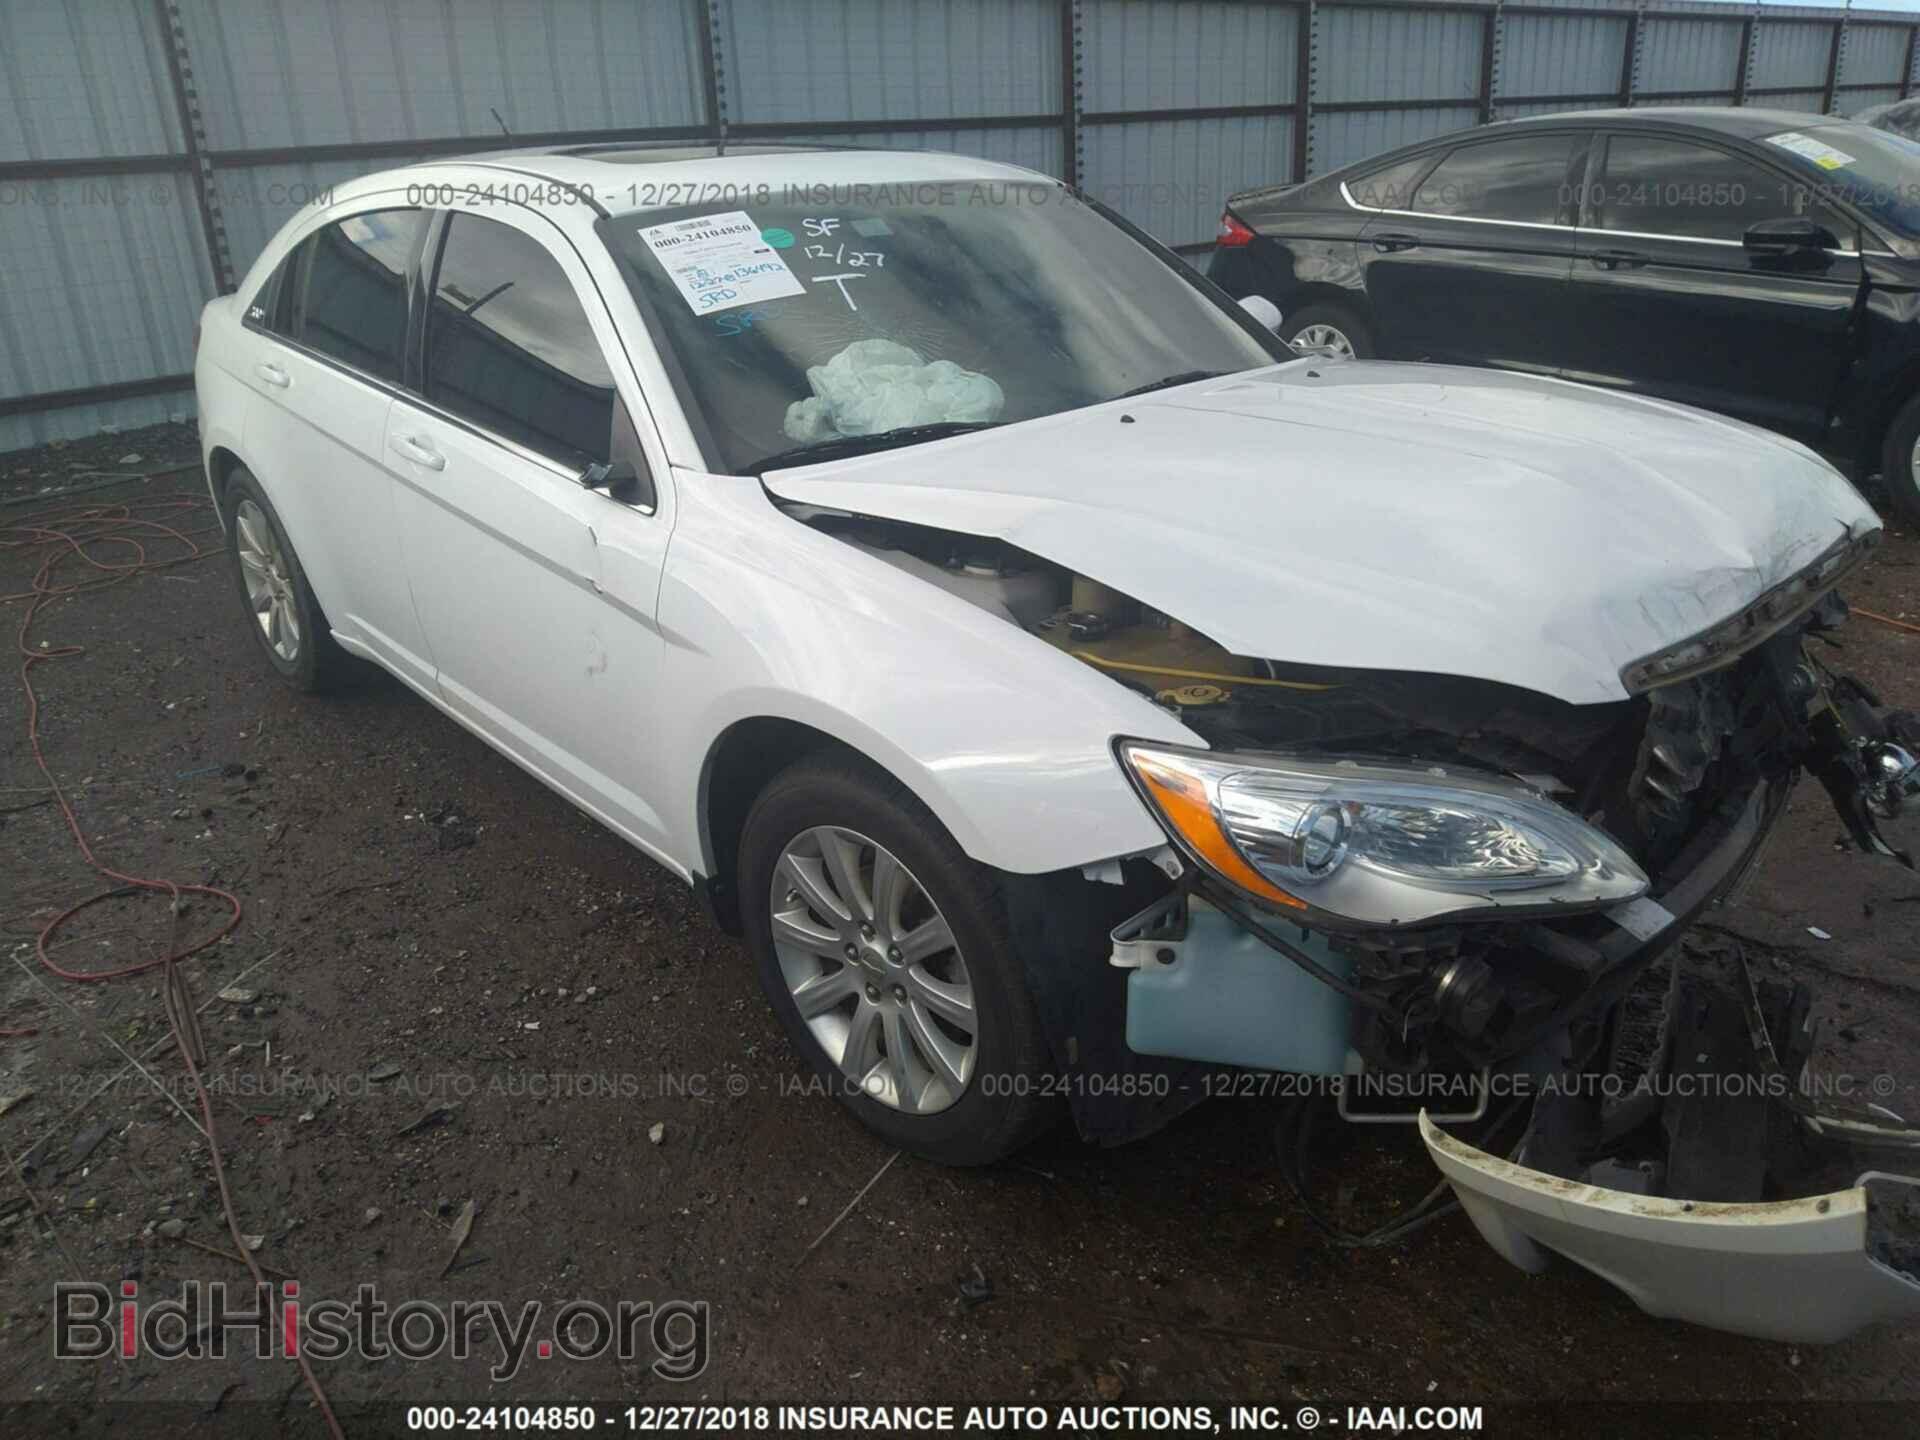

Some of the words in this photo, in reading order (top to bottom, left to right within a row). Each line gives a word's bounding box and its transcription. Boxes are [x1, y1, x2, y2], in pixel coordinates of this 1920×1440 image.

[653, 224, 752, 249] 000-24104850
[802, 217, 840, 238] SF
[804, 243, 885, 267] 12/27
[811, 273, 866, 311] T
